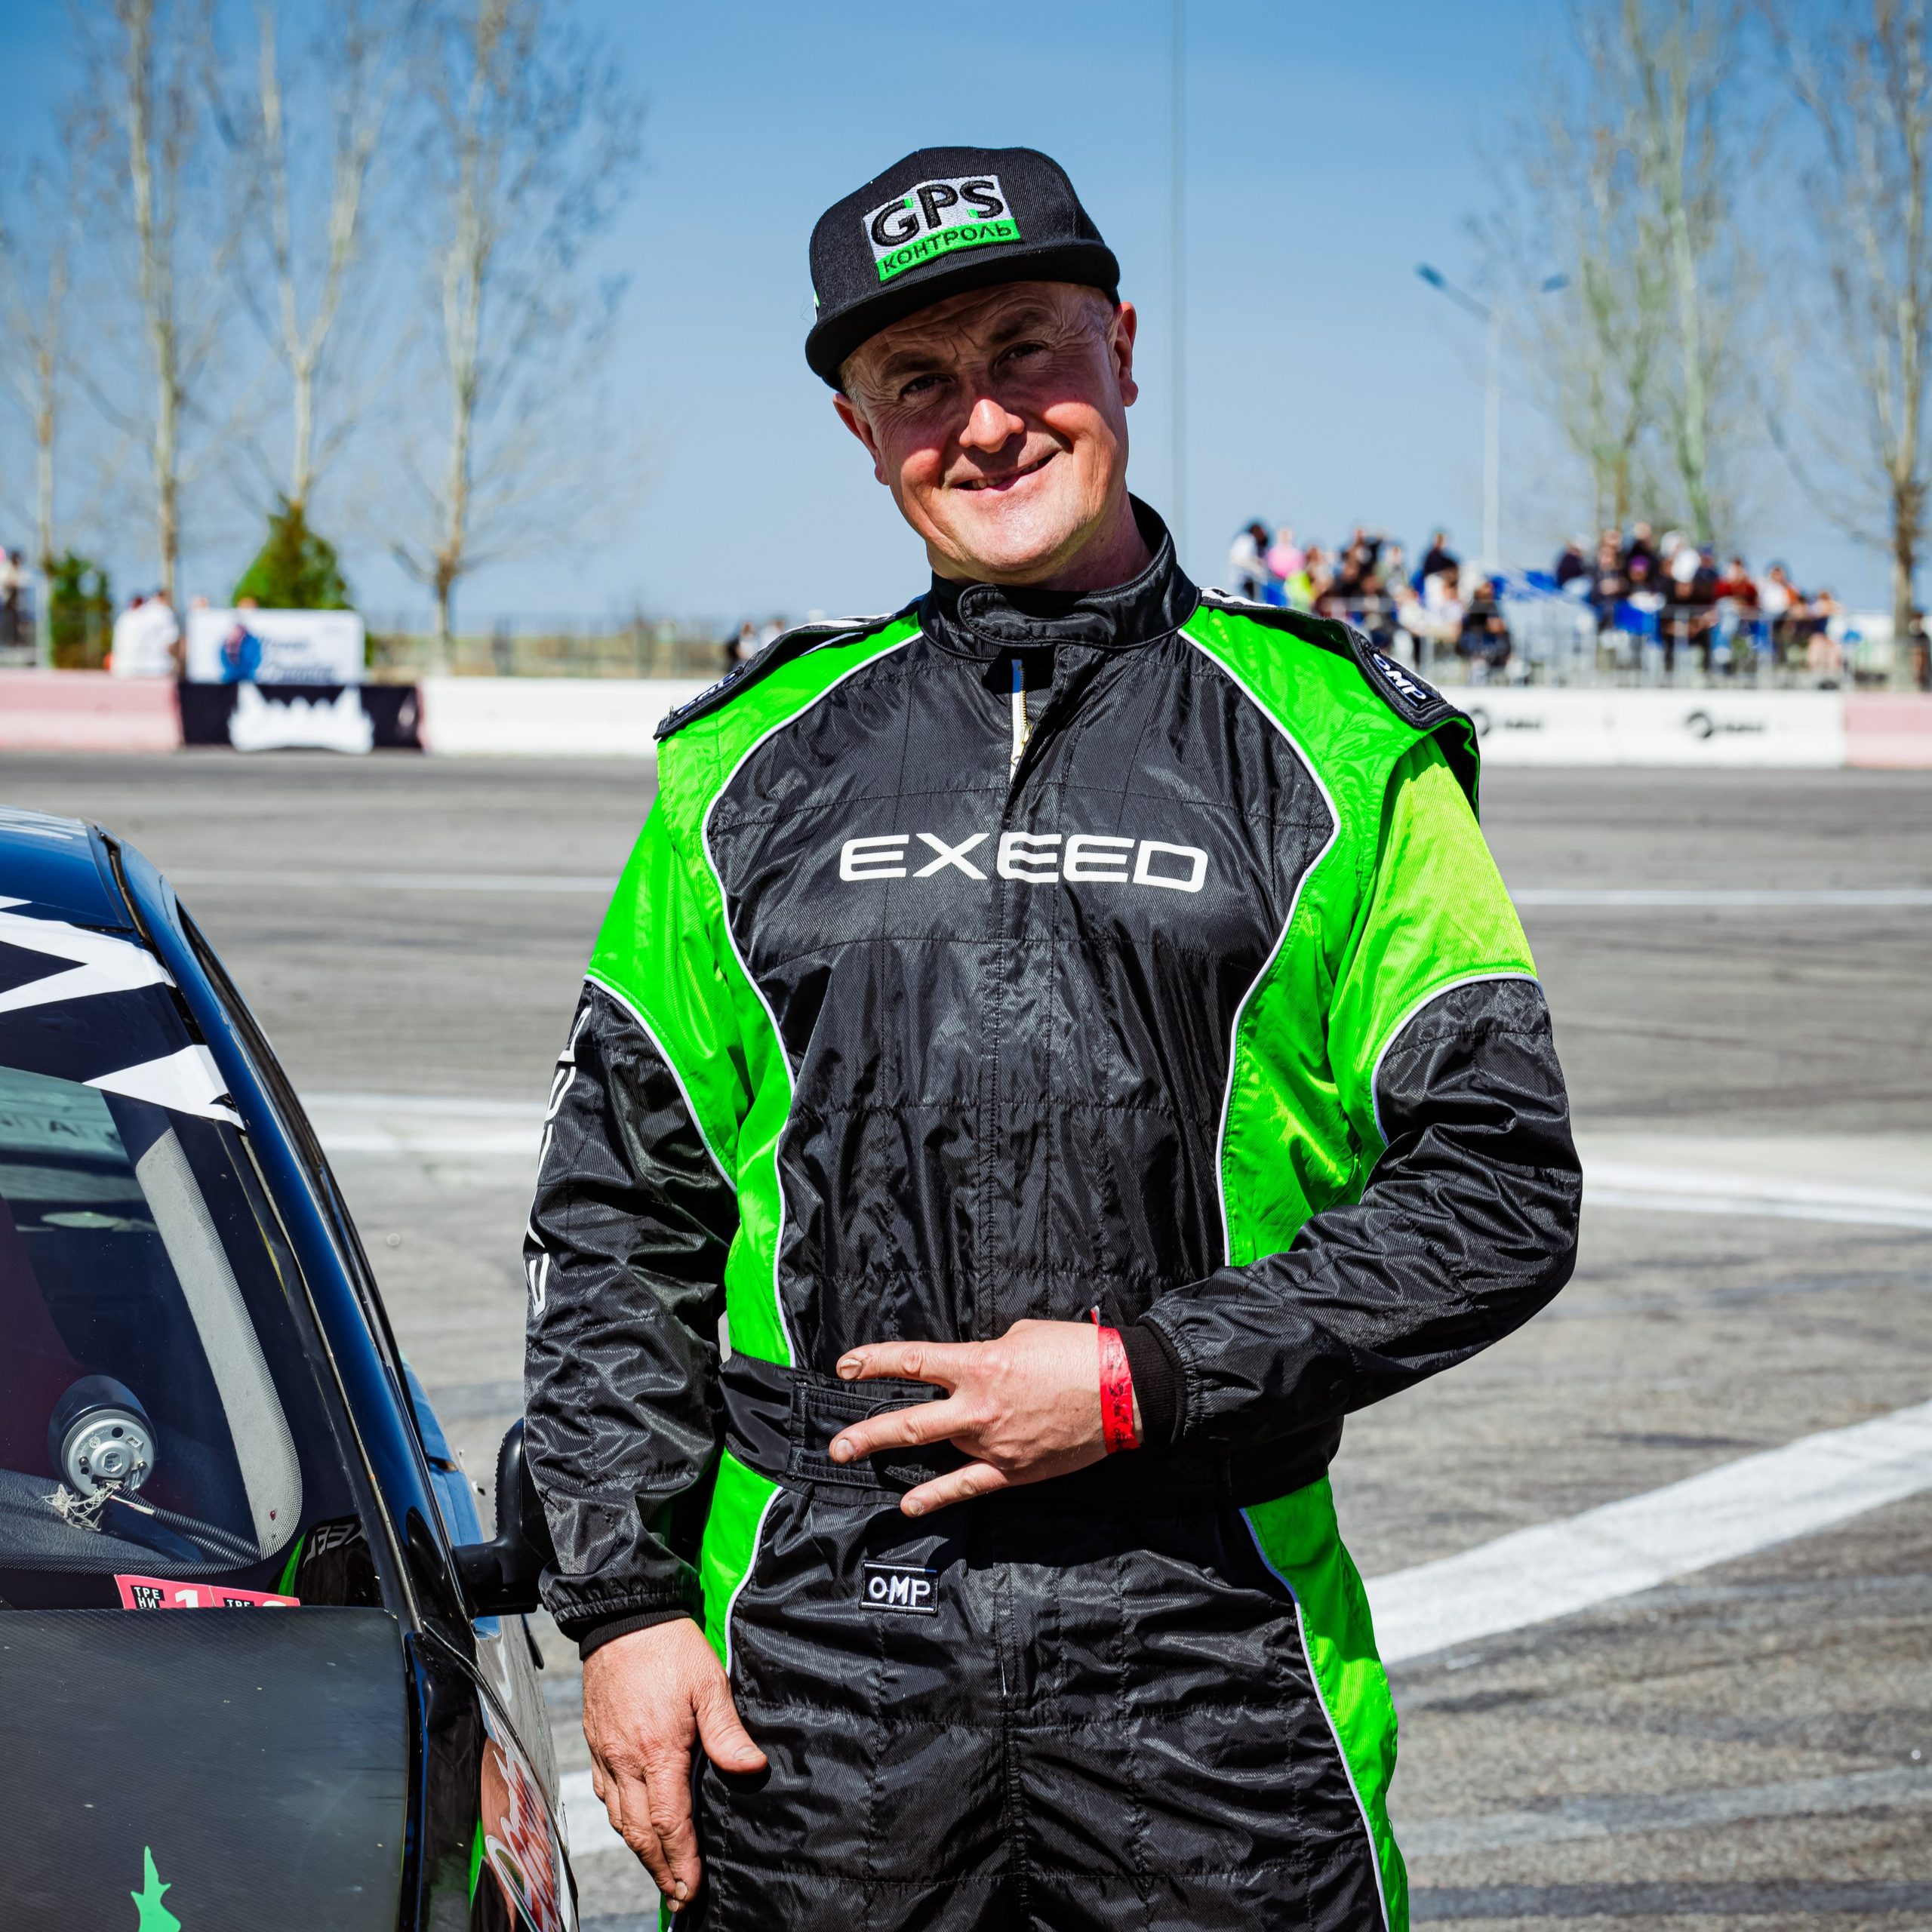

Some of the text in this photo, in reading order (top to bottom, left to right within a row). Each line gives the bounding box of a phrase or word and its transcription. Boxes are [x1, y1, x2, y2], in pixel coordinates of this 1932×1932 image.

[871, 180, 1004, 247] GPS
[881, 223, 1012, 273] КОНТРОЛЬ
[1373, 652, 1426, 701] OMP
[839, 831, 1208, 894] EXEED
[869, 1575, 931, 1607] OMP
